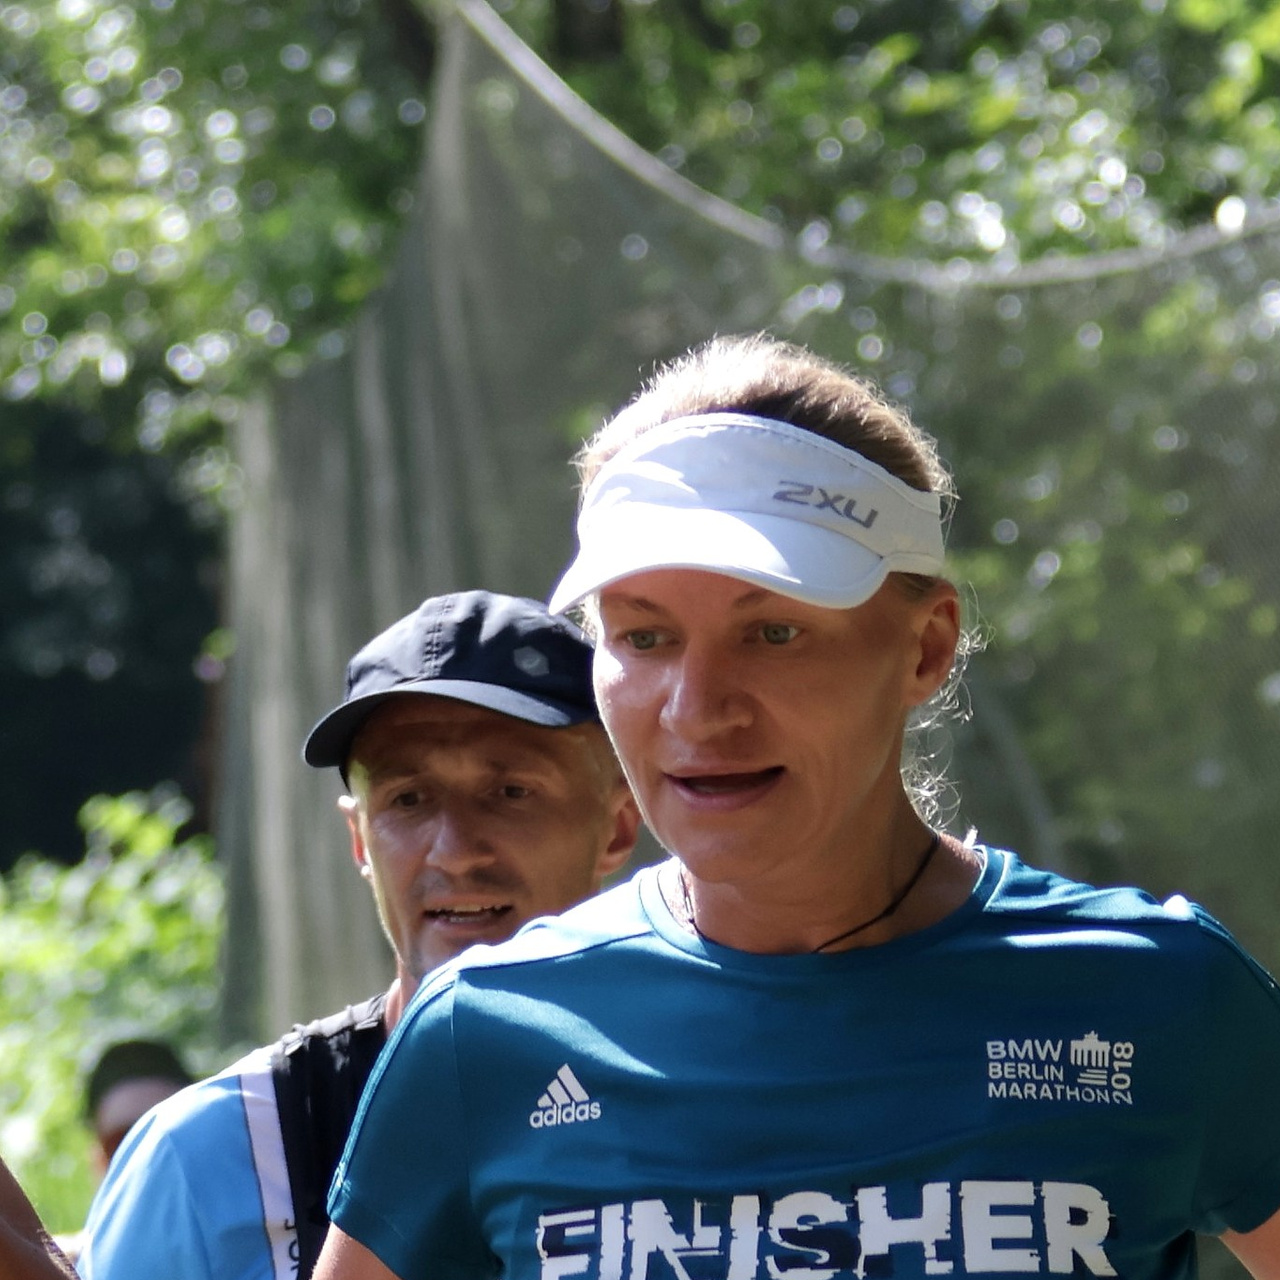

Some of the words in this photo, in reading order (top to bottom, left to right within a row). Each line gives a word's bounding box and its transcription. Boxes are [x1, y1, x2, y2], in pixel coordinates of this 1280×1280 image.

[773, 480, 878, 529] 2XU
[986, 1038, 1063, 1062] BMW
[988, 1061, 1064, 1082] BERLIN
[1111, 1041, 1135, 1105] 2018
[987, 1081, 1111, 1104] MARATHON
[529, 1101, 602, 1129] adidas
